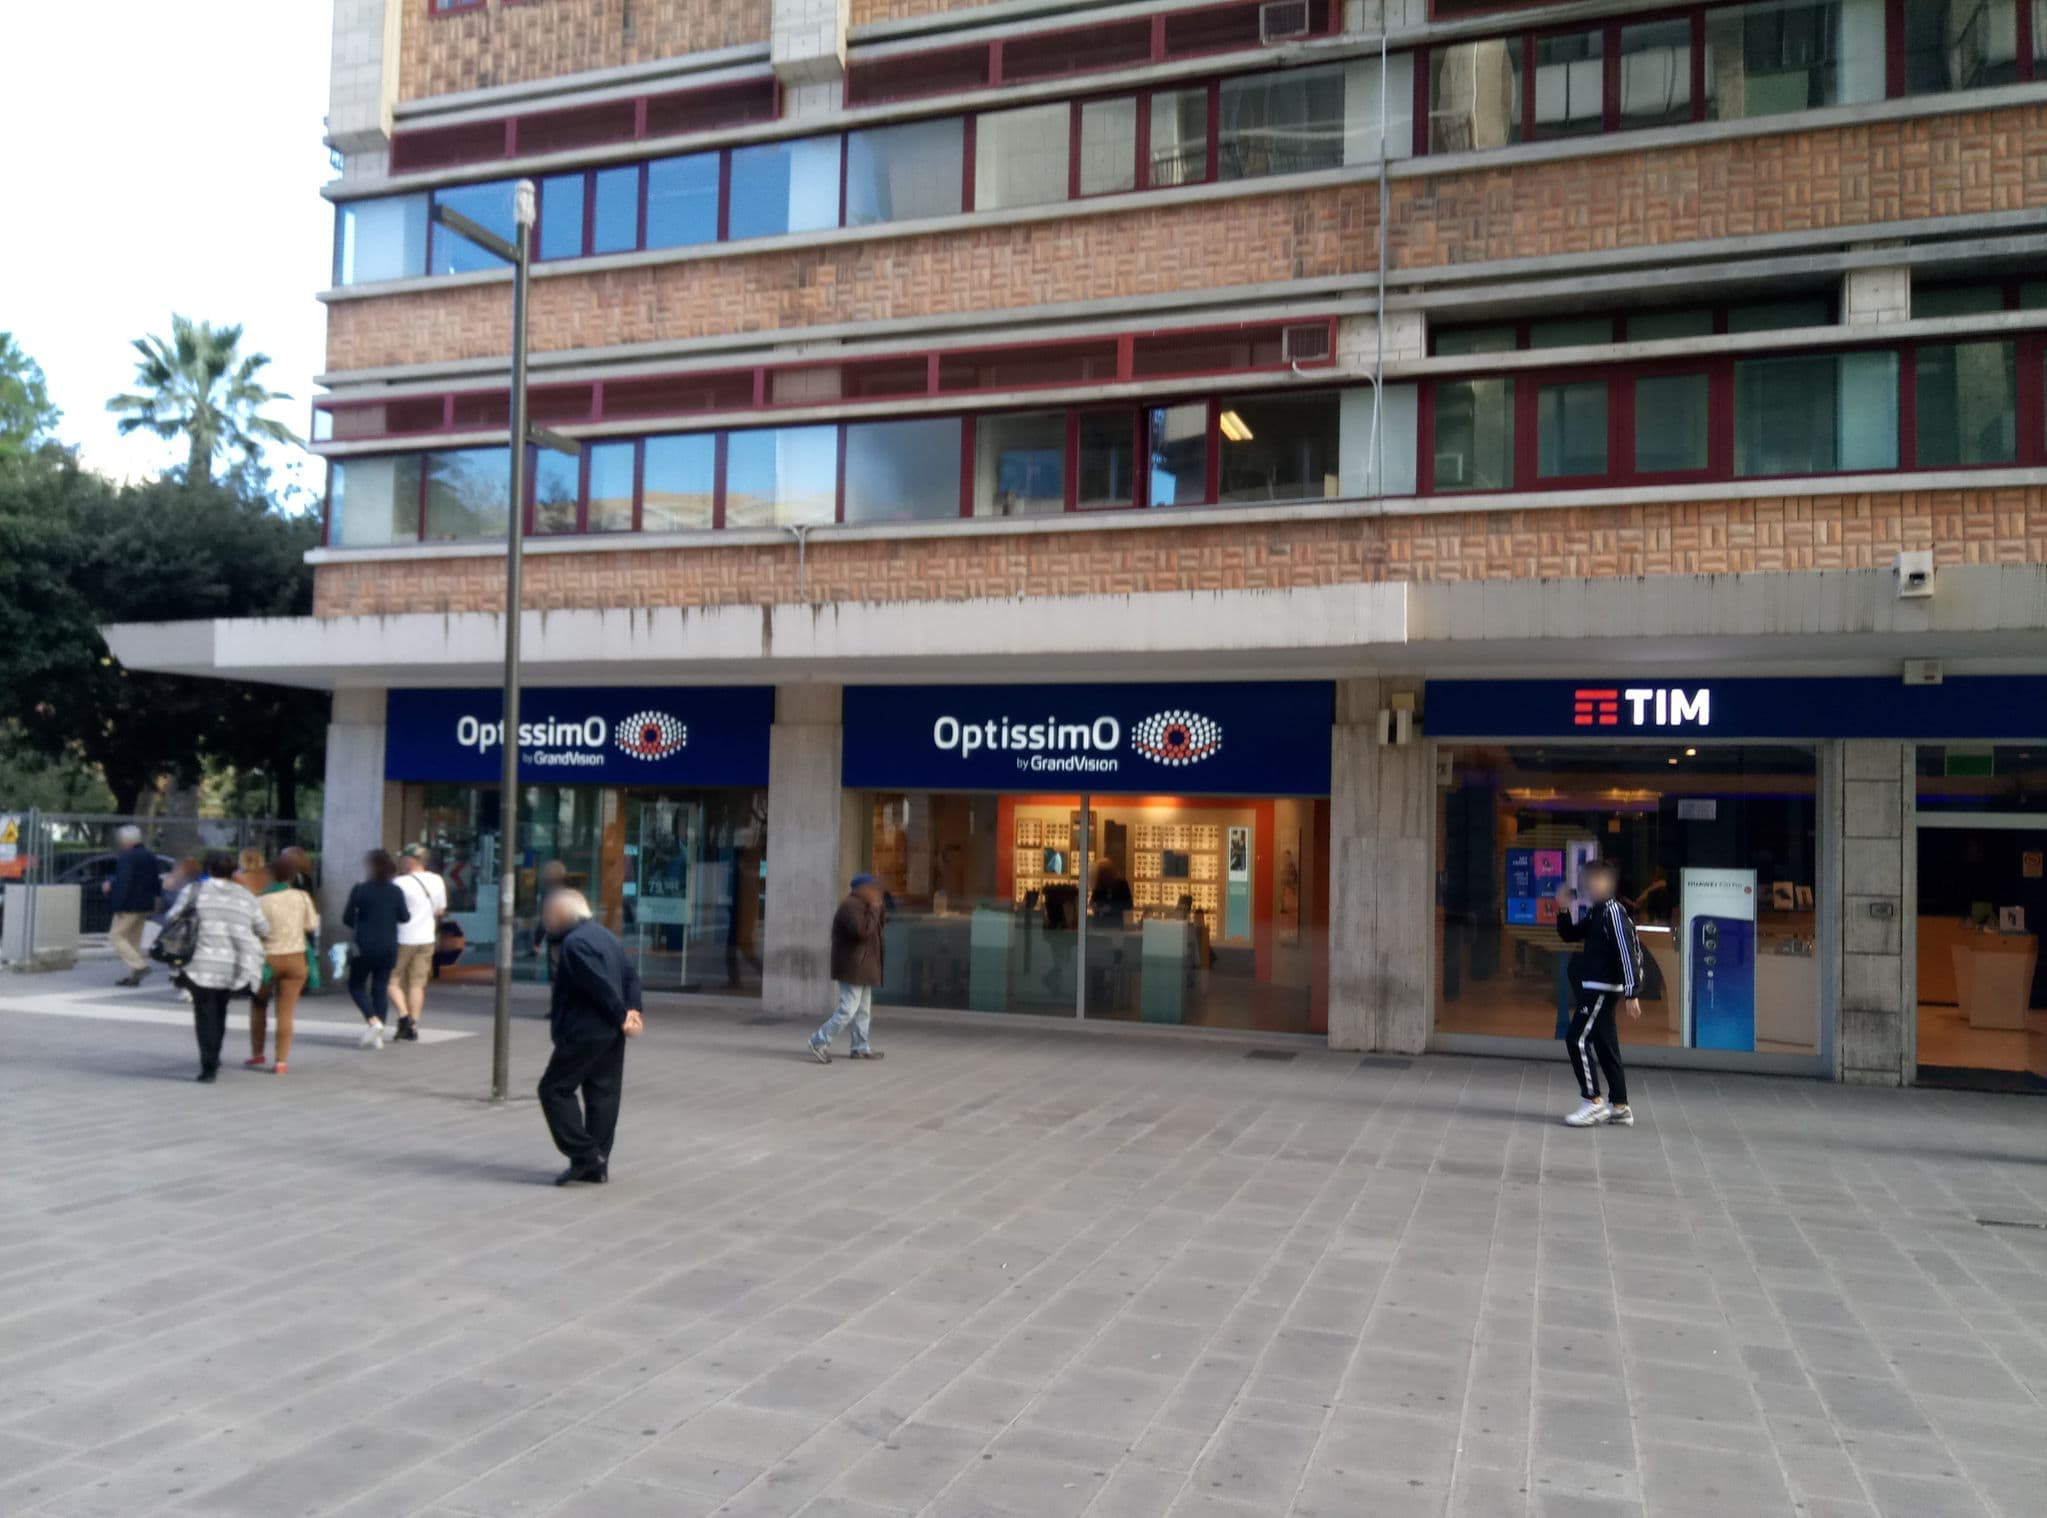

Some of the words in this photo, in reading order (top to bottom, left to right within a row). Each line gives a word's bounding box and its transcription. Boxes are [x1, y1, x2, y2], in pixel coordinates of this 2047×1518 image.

[1624, 688, 1711, 726] TIM
[456, 714, 607, 755] OptssimO
[933, 715, 1121, 760] OptissimO
[534, 751, 605, 766] GrandVision
[1016, 757, 1029, 772] by
[1030, 755, 1119, 772] GrandVision
